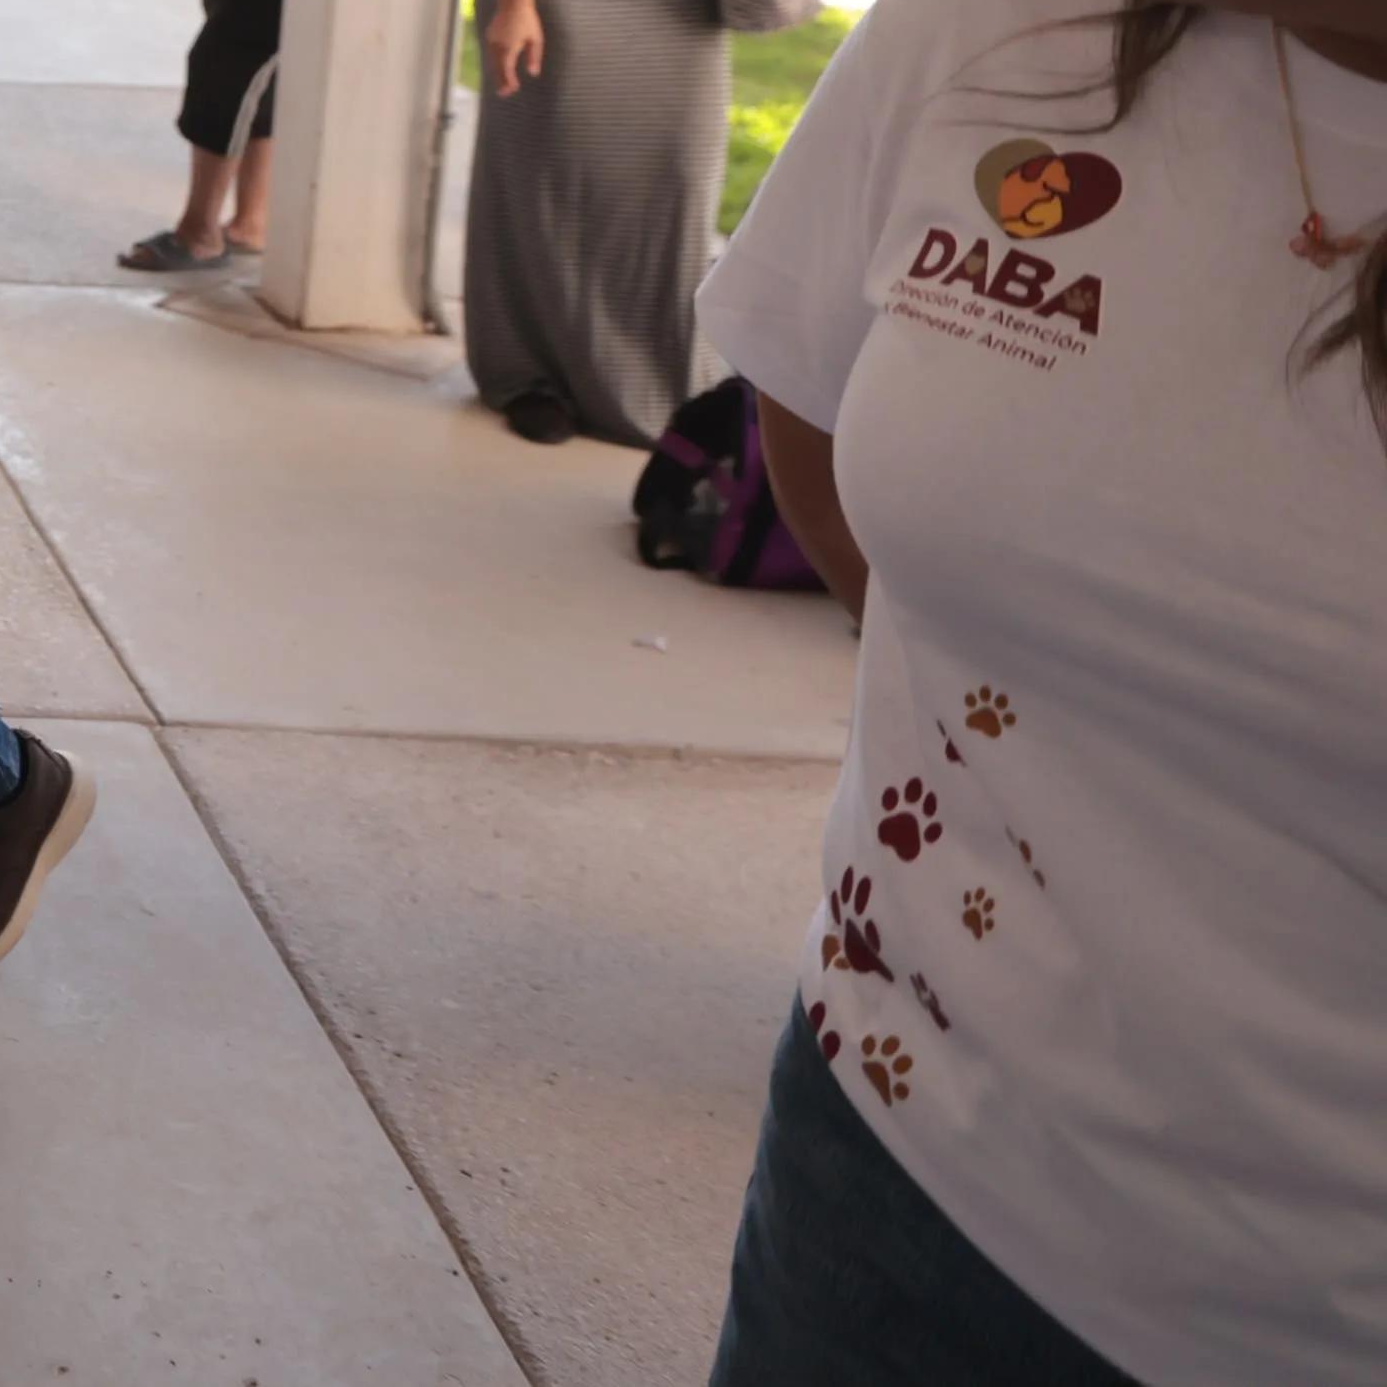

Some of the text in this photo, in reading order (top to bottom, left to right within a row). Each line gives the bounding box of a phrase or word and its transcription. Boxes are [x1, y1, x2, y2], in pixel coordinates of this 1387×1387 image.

[908, 227, 1102, 337] DABA
[962, 299, 986, 317] de
[989, 309, 1088, 355] Atención
[978, 333, 1057, 371] Animal
